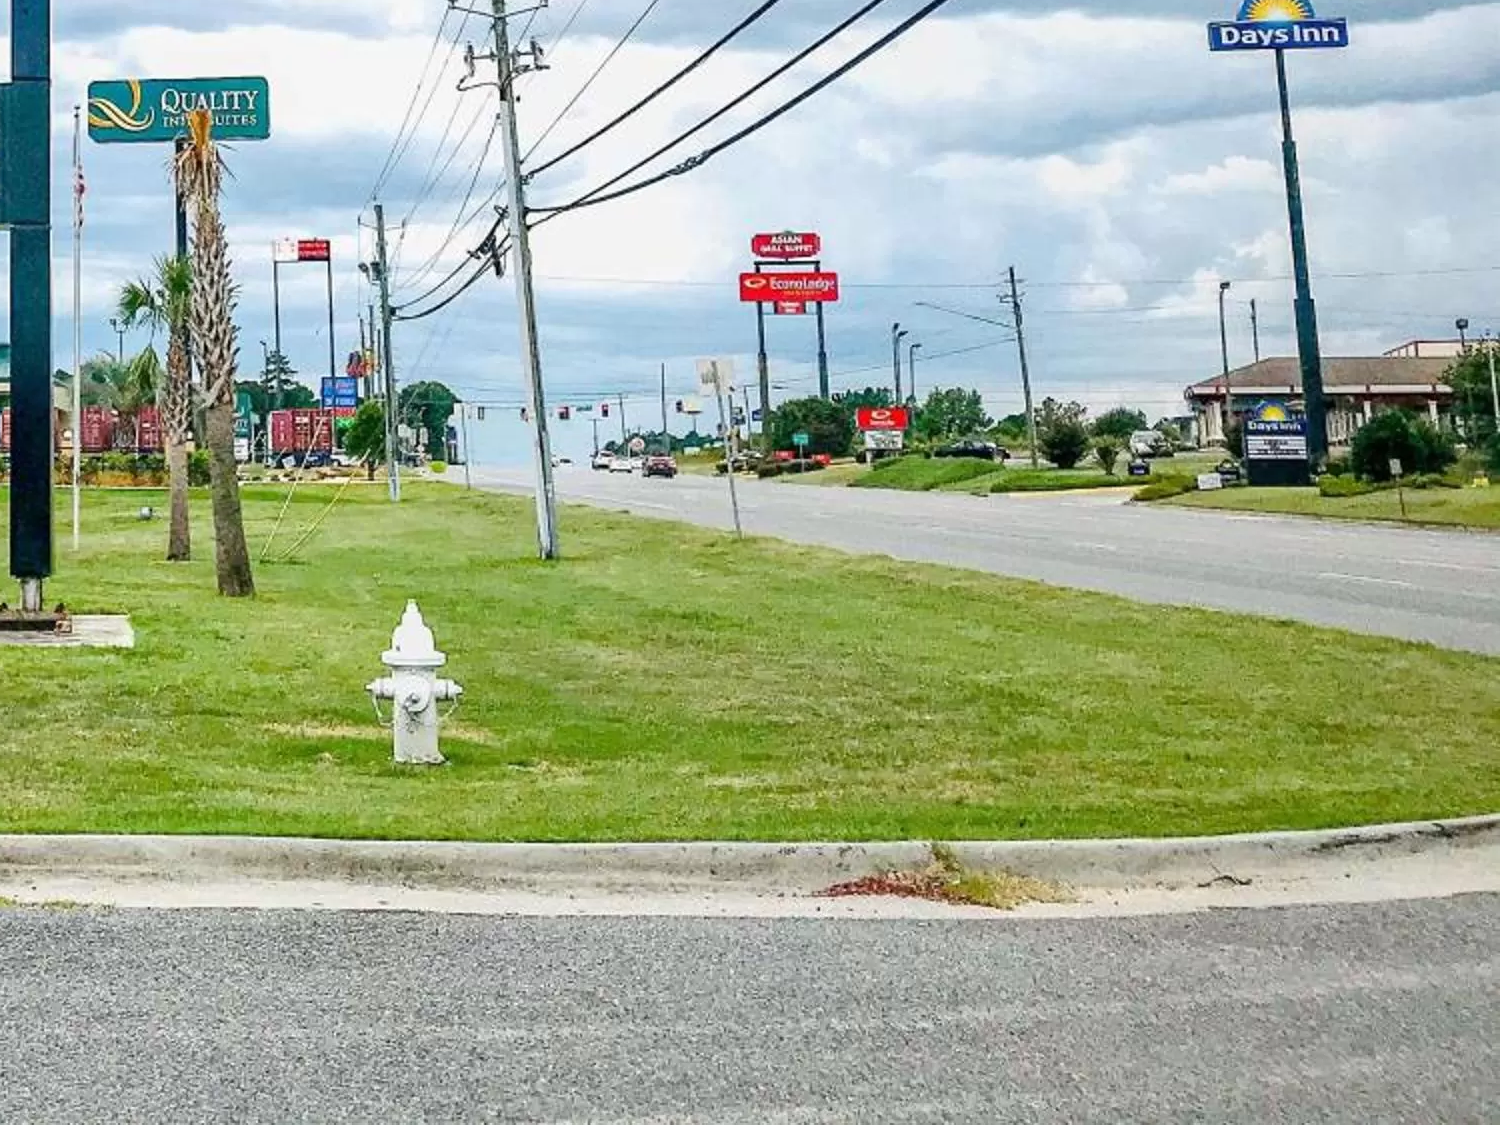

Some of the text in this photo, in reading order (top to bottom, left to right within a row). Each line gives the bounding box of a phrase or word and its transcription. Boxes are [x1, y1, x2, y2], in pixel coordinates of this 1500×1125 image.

[1220, 25, 1340, 46] Days Inn
[161, 88, 258, 113] QUALITY
